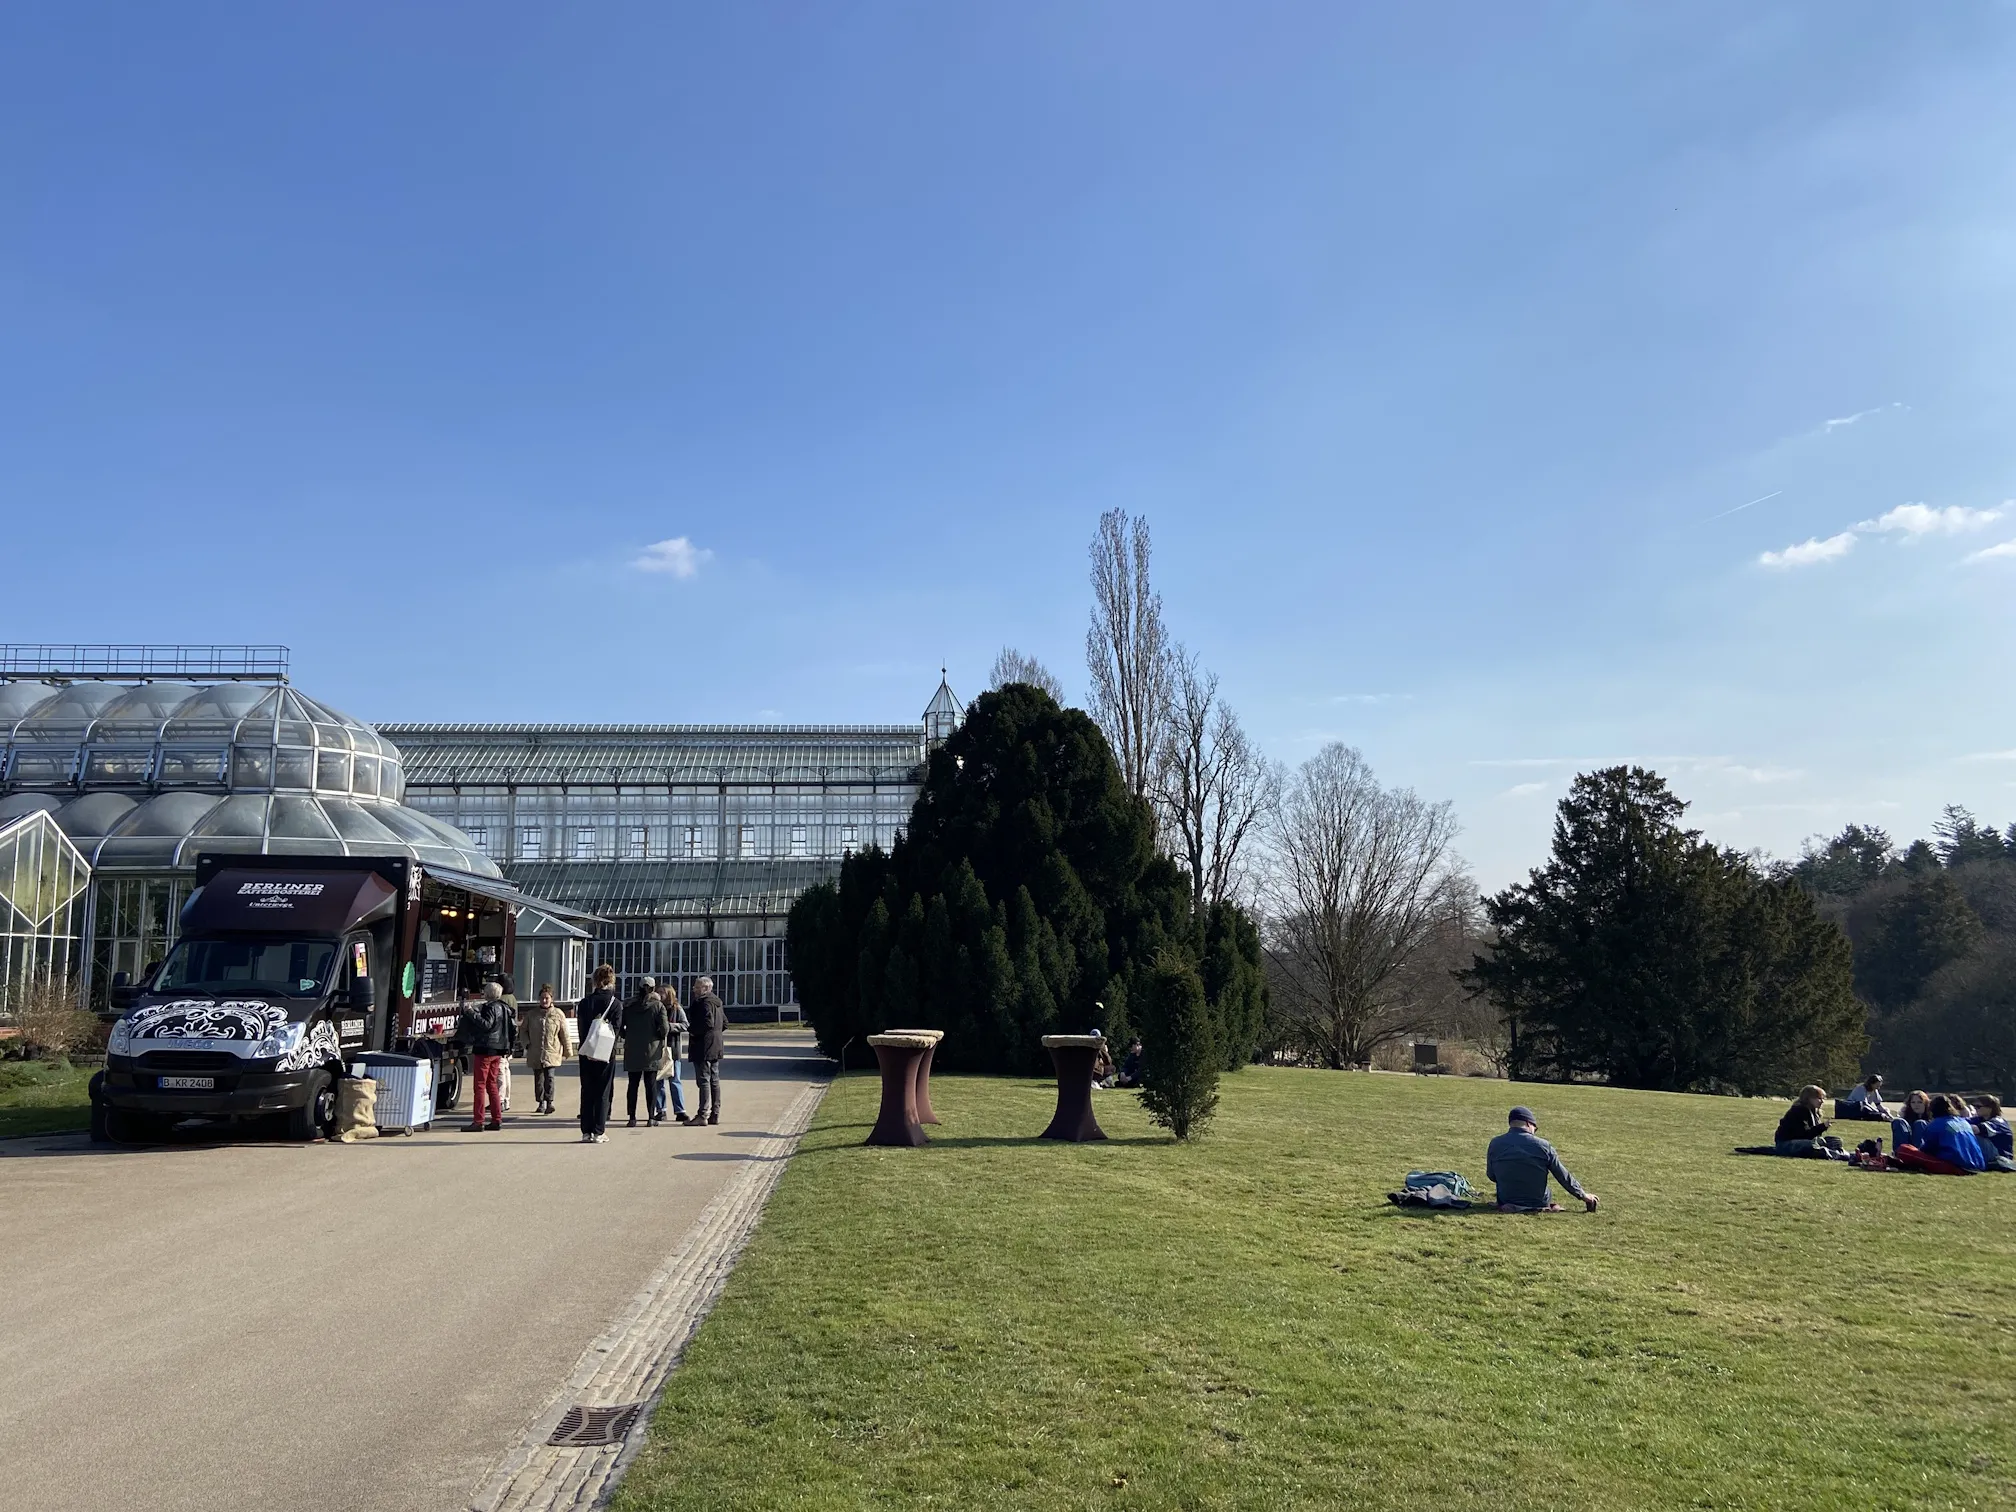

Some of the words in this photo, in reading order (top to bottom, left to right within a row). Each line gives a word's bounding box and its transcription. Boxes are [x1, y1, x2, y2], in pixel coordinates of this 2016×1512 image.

[240, 883, 324, 891] BERLINER
[415, 1018, 427, 1034] EIN
[168, 1040, 214, 1049] IVECO
[163, 1079, 170, 1087] B
[175, 1079, 188, 1087] KR
[189, 1079, 213, 1088] 2408
